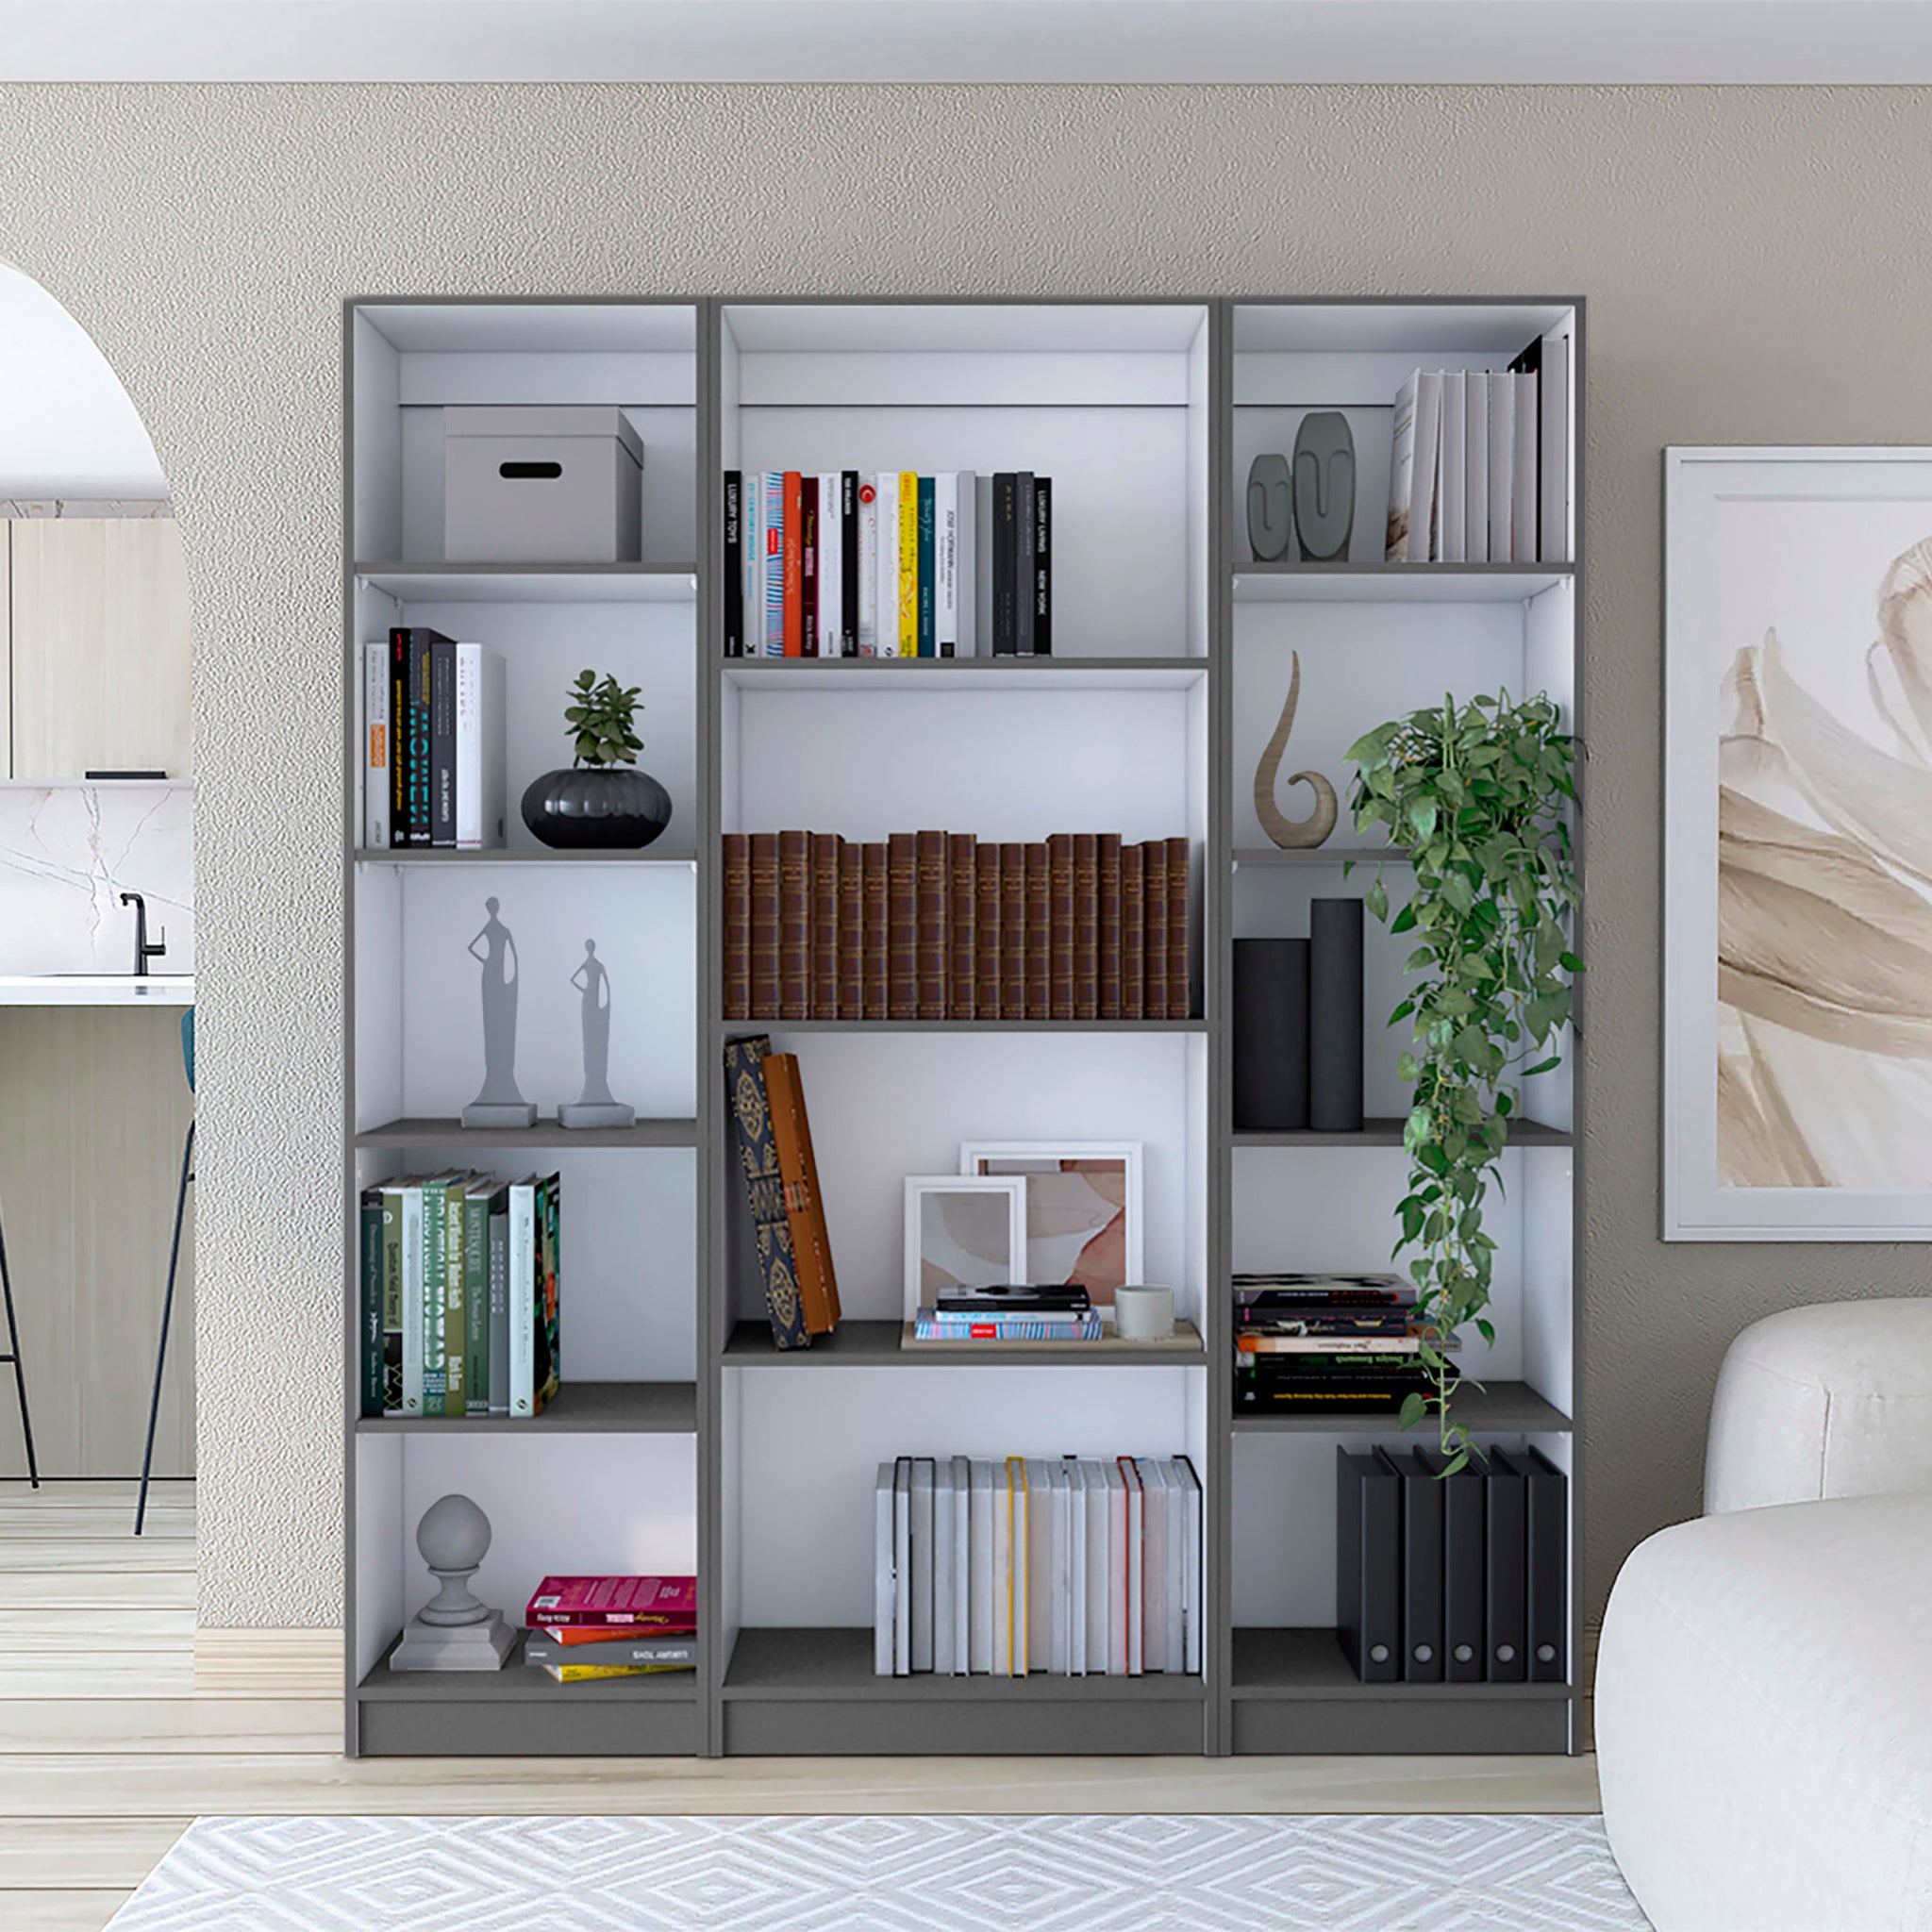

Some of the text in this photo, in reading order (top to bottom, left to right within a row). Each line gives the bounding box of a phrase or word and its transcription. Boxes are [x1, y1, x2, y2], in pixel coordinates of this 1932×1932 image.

[727, 483, 738, 543] LUXURY TOYS
[1038, 490, 1046, 615] LUXURY LIVING NEW YORK
[387, 1242, 398, 1274] Quantum
[424, 1195, 445, 1282] PRACTICAL
[424, 1285, 445, 1370] NOMAD
[633, 1650, 689, 1659] LUXURY TOYS
